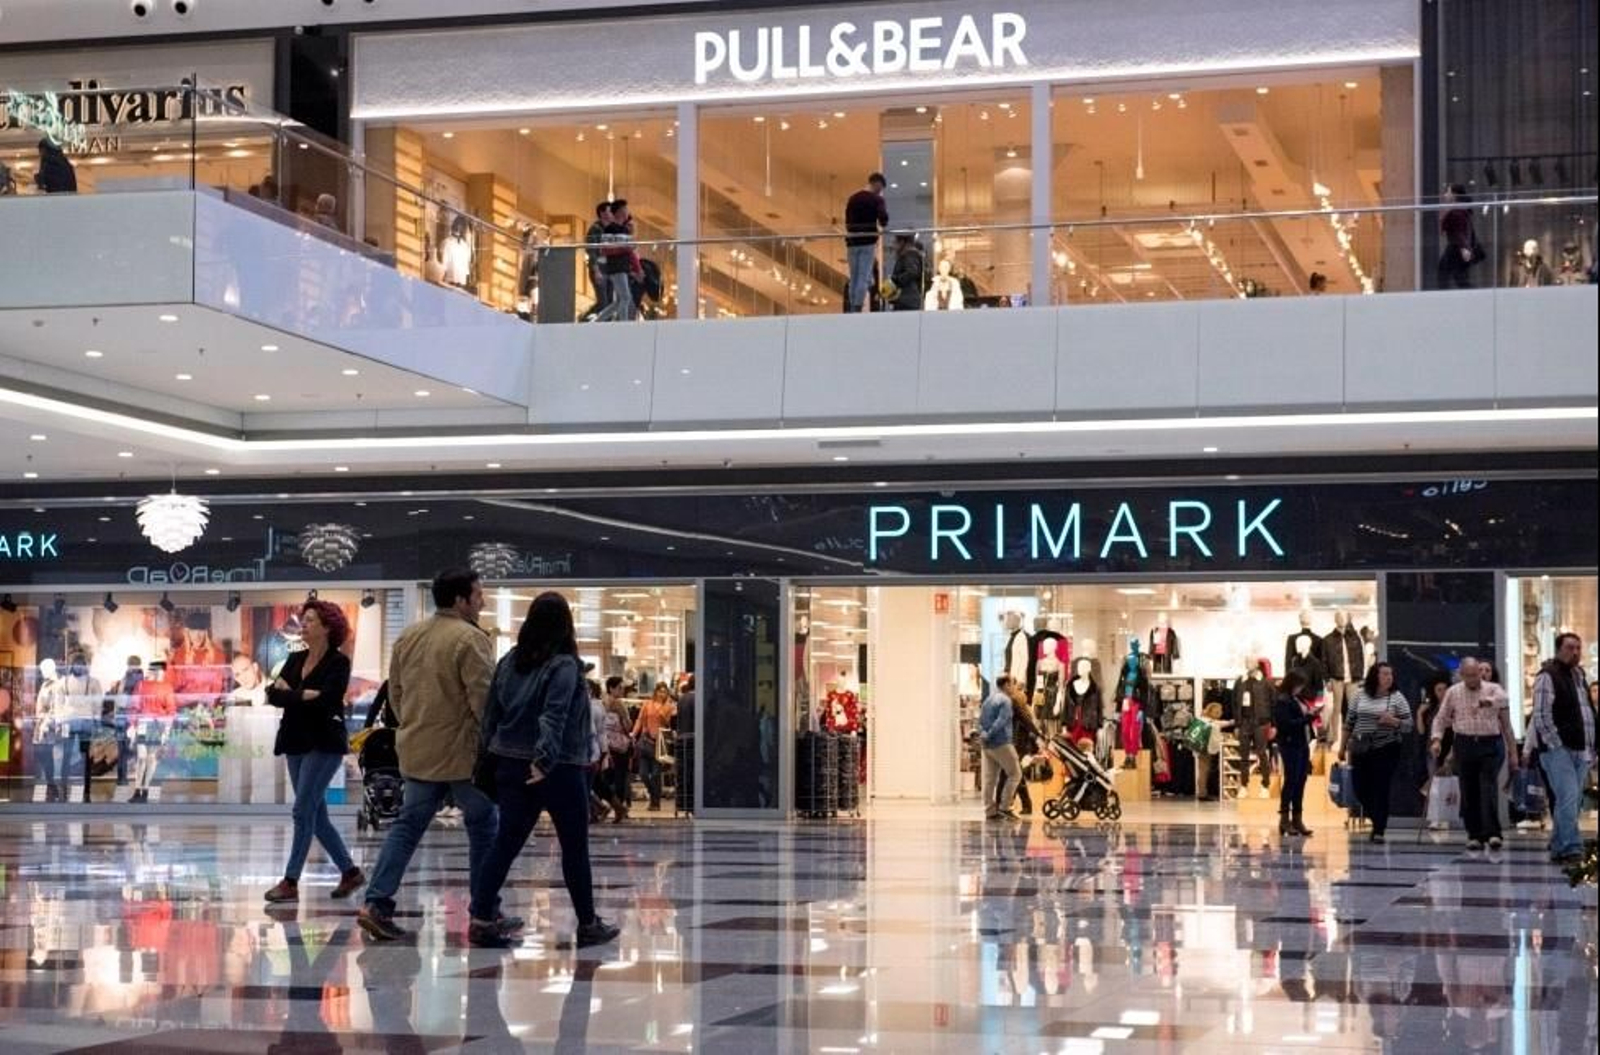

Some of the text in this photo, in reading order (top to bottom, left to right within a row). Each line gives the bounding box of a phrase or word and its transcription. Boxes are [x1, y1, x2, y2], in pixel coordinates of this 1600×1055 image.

[695, 12, 1028, 85] PULL&BEAR
[0, 78, 246, 129] rdivarius
[869, 499, 1285, 560] PRIMARK
